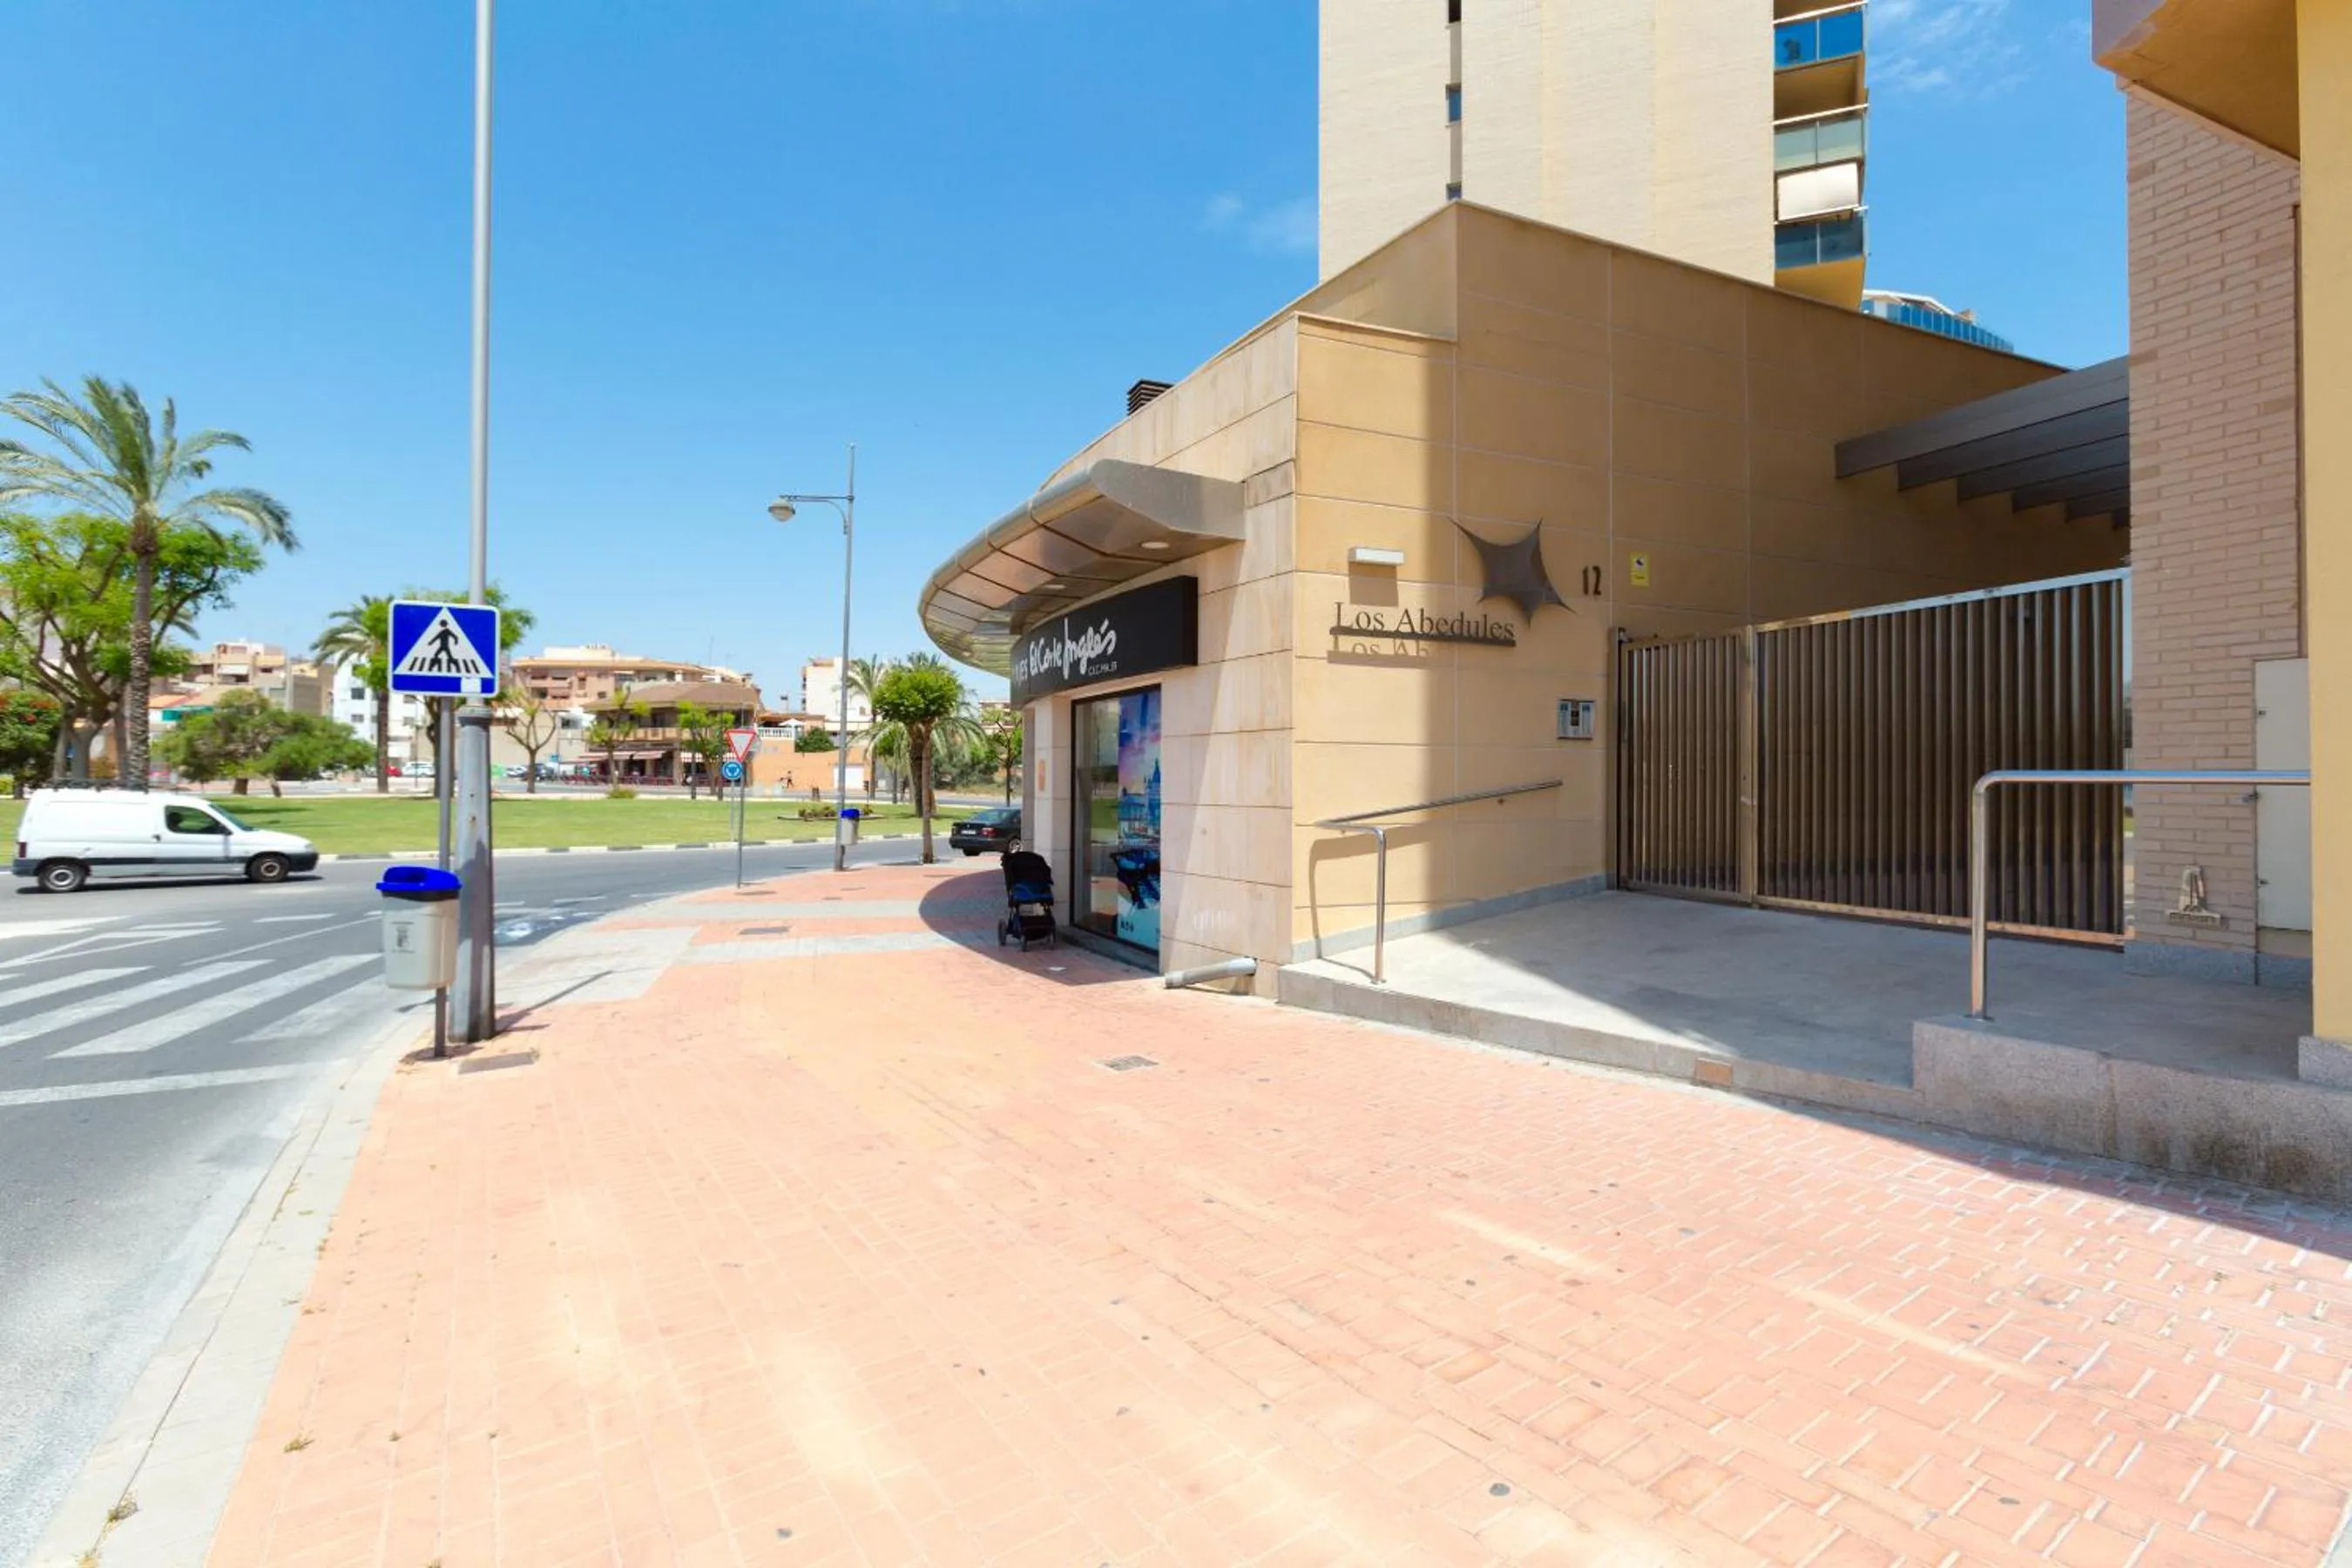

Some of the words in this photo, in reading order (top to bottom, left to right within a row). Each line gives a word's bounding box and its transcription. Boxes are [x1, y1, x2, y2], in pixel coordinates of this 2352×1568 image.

[1582, 565, 1602, 597] 12
[1334, 601, 1385, 631] Los
[1396, 607, 1515, 639] Abedules
[1037, 637, 1062, 673] Corte
[1063, 617, 1117, 679] Inglés
